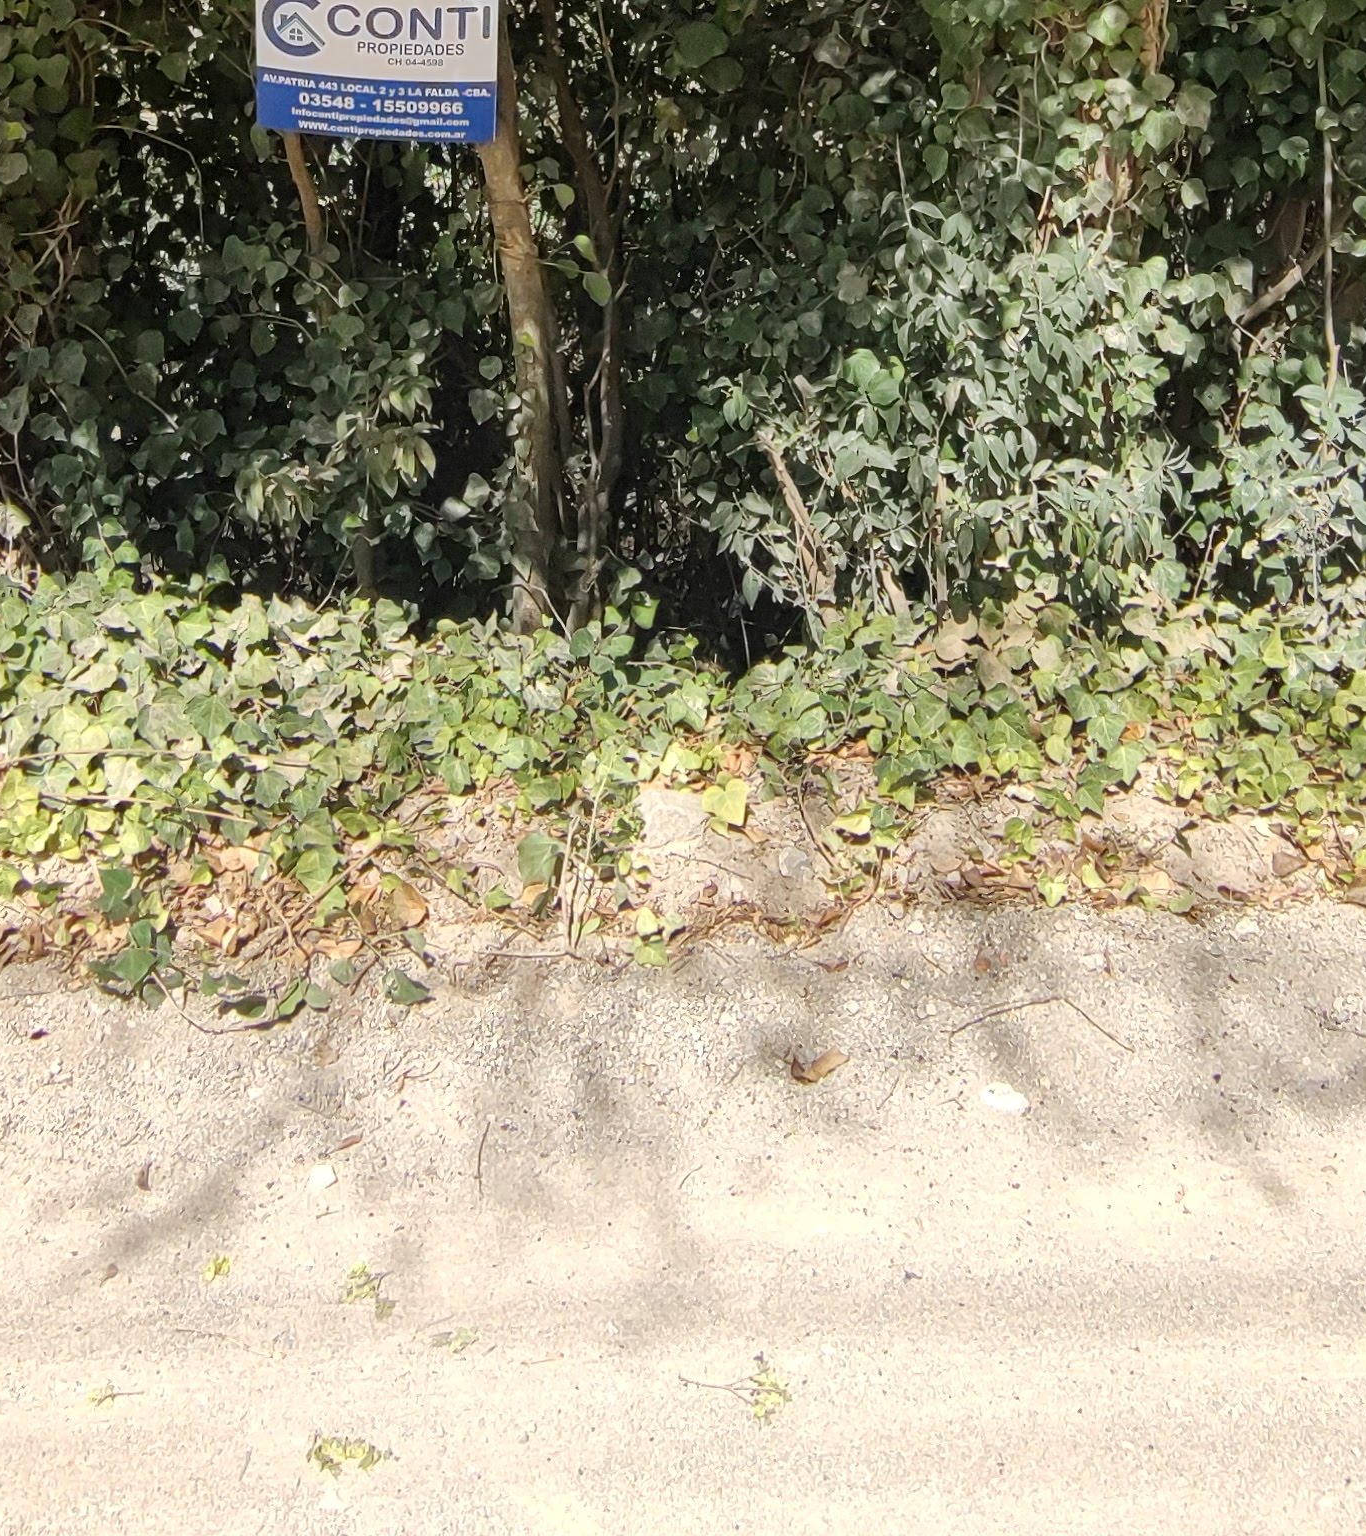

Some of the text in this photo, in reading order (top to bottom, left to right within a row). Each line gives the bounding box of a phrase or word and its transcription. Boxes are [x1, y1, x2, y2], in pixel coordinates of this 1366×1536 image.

[327, 4, 490, 40] CONTI
[358, 42, 464, 55] PROPIEDADES
[388, 58, 402, 66] CH
[319, 81, 337, 91] 443
[341, 83, 376, 94] LOCAL
[379, 86, 386, 95] 2
[389, 88, 395, 97] y
[398, 87, 405, 96] 3
[408, 87, 422, 97] LA
[425, 88, 459, 97] FALDA
[299, 93, 354, 109] 03548
[373, 99, 463, 114] 15509966
